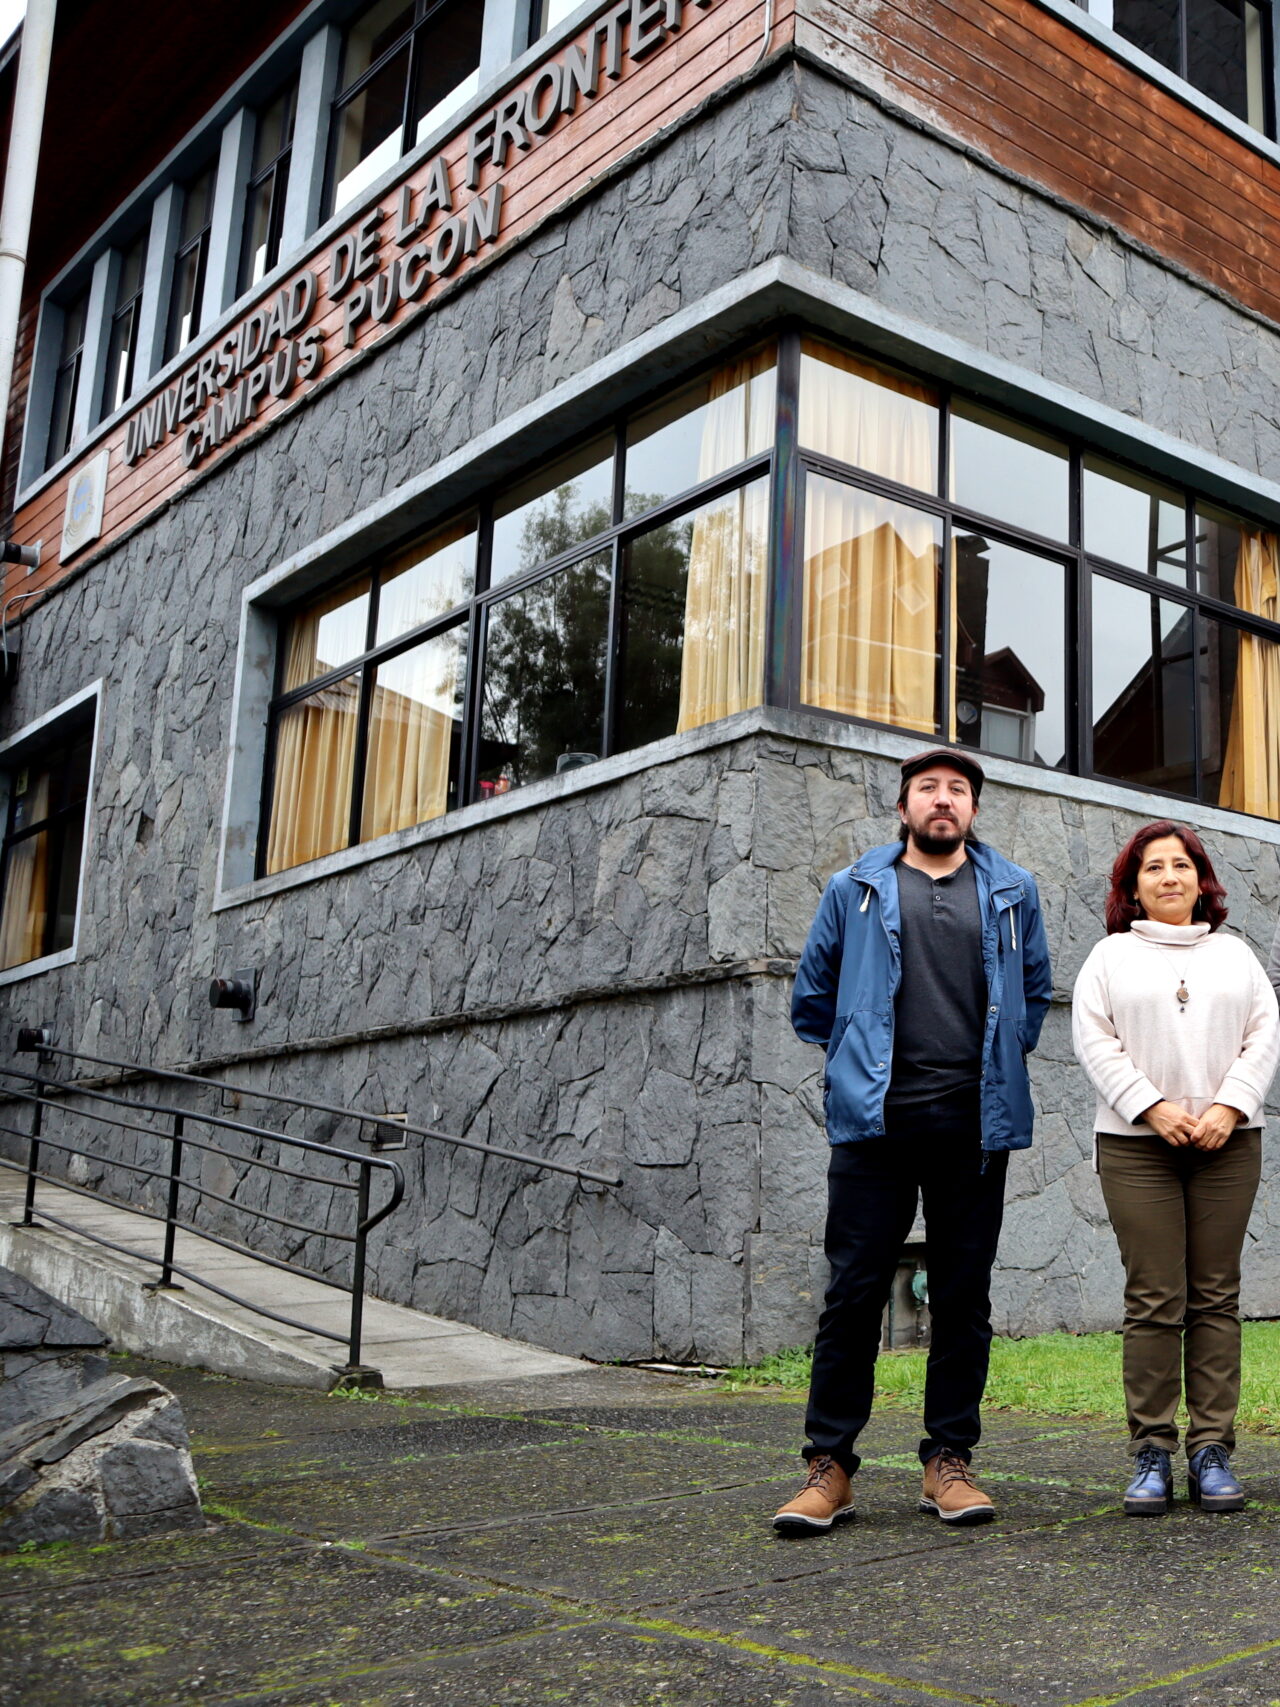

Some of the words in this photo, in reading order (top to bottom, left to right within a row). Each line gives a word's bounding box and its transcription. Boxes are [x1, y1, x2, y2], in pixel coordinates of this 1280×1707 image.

[124, 269, 317, 466] UNIVERSIDAD
[328, 207, 385, 300] DE
[396, 156, 452, 248] LA
[182, 326, 325, 468] CAMPUS
[343, 183, 503, 348] PUCON
